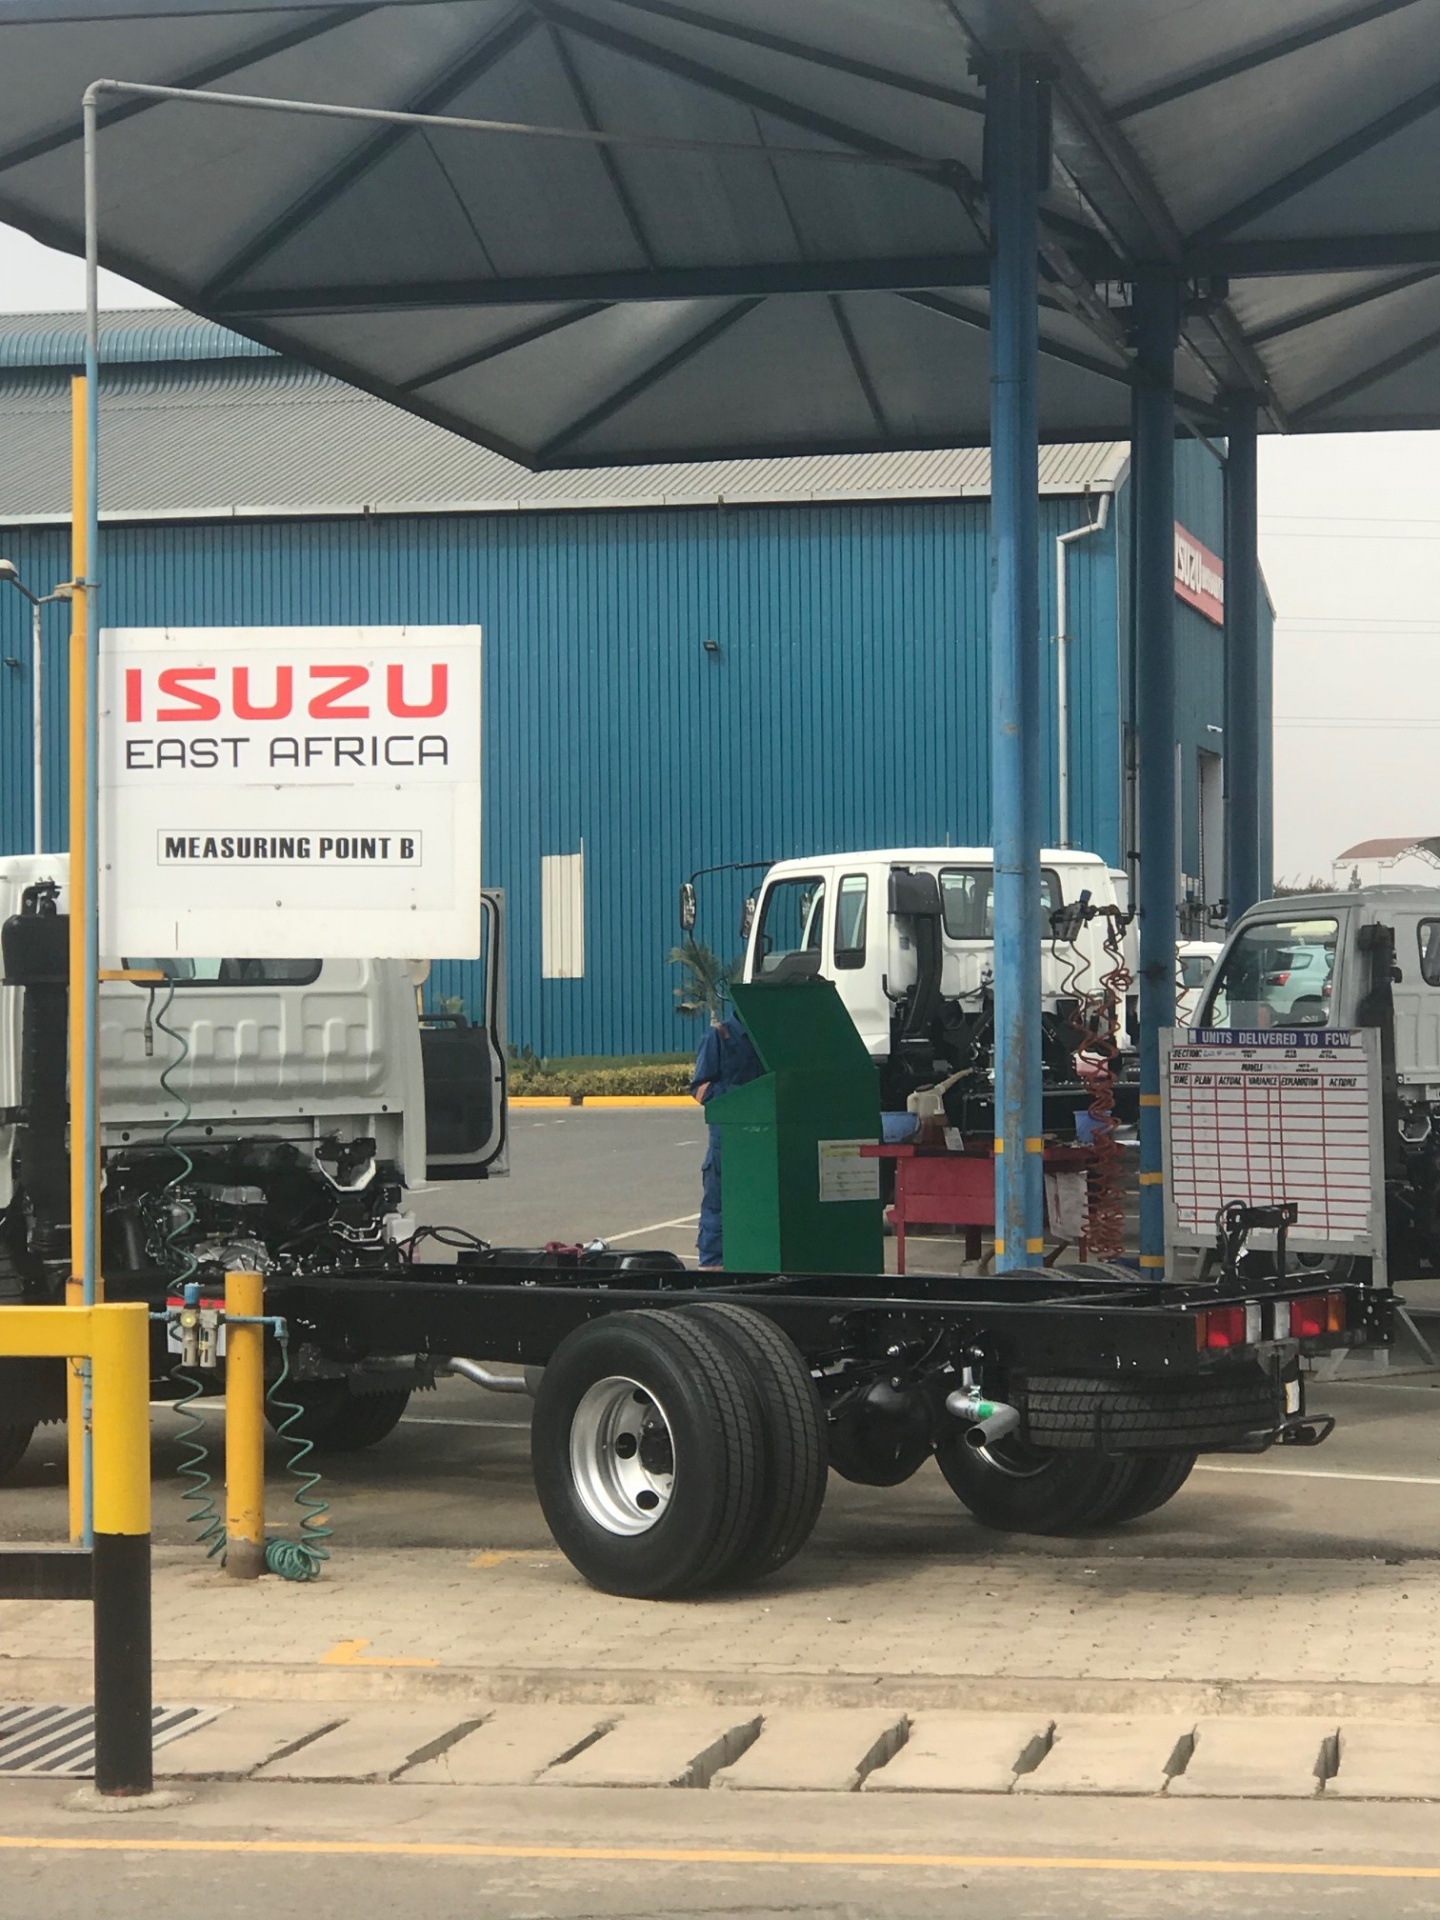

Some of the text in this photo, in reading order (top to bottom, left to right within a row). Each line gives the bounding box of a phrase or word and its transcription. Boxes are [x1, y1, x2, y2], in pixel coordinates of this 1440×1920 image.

[125, 663, 449, 723] ISUZU
[125, 735, 449, 769] EAST AFRICA
[165, 836, 414, 859] MEASURING POINT B
[1201, 1032, 1351, 1046] UNITS DELIVERED TO FCW
[1194, 1075, 1212, 1085] PLAN
[1218, 1076, 1242, 1085] ACTUAL
